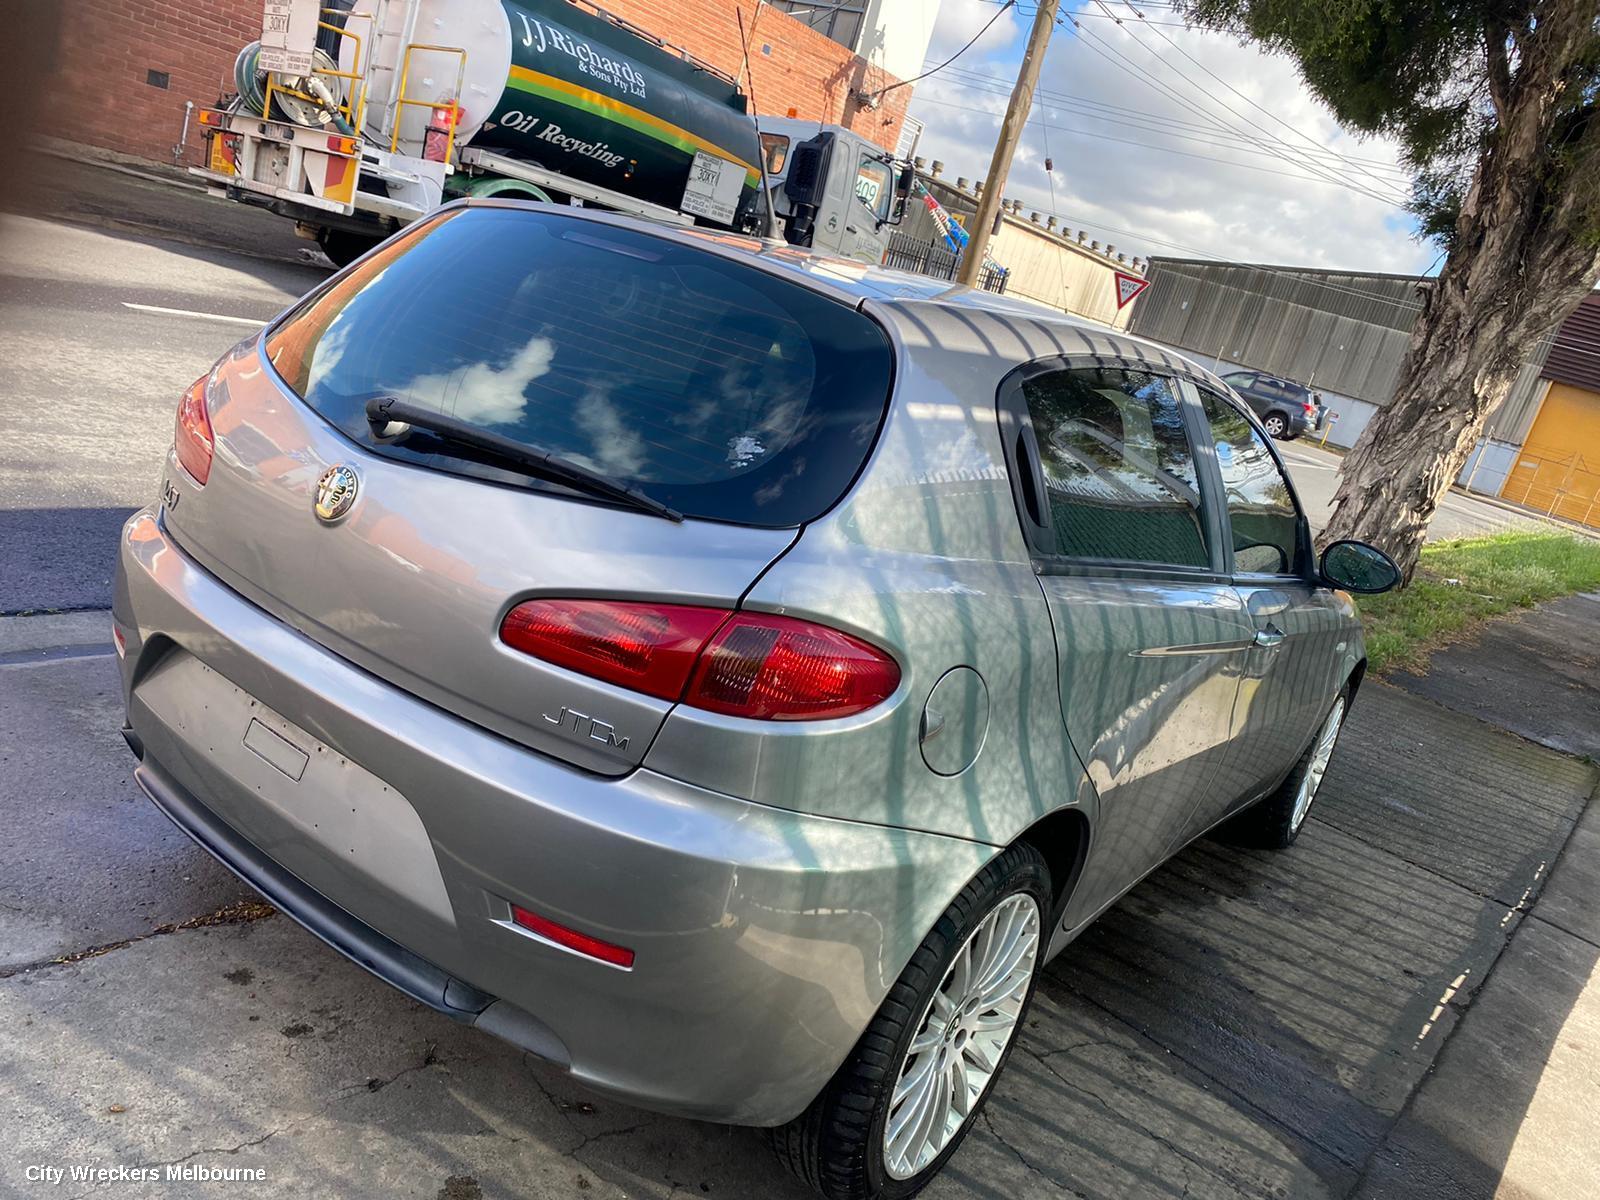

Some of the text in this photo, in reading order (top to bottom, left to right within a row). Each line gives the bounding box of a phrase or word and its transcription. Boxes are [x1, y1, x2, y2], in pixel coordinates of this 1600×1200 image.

[578, 60, 646, 99] & Sons Pty Ltd
[500, 110, 625, 168] Oil Recycling
[1121, 281, 1137, 290] GIVE
[341, 468, 355, 500] ROMEO
